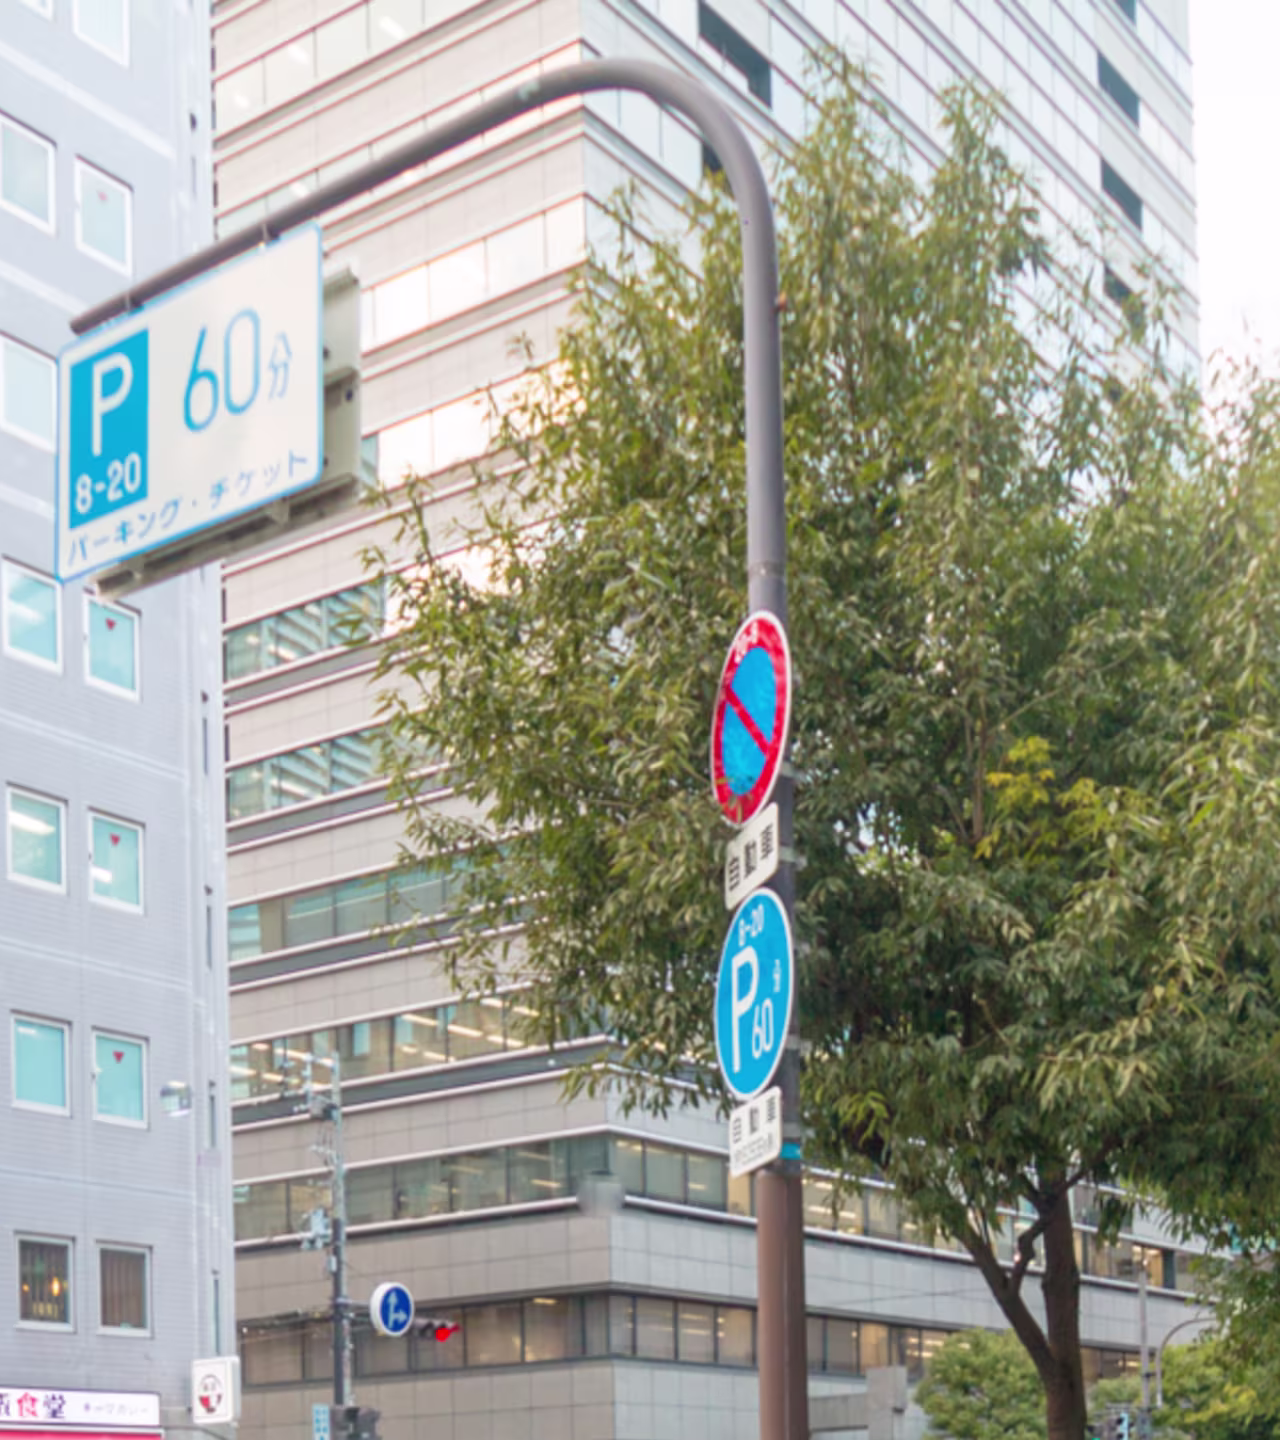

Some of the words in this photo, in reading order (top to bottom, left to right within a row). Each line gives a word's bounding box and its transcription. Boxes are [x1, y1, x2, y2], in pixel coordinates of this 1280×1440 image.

[92, 351, 133, 457] P
[75, 451, 142, 515] 8-20
[730, 945, 759, 1075] P
